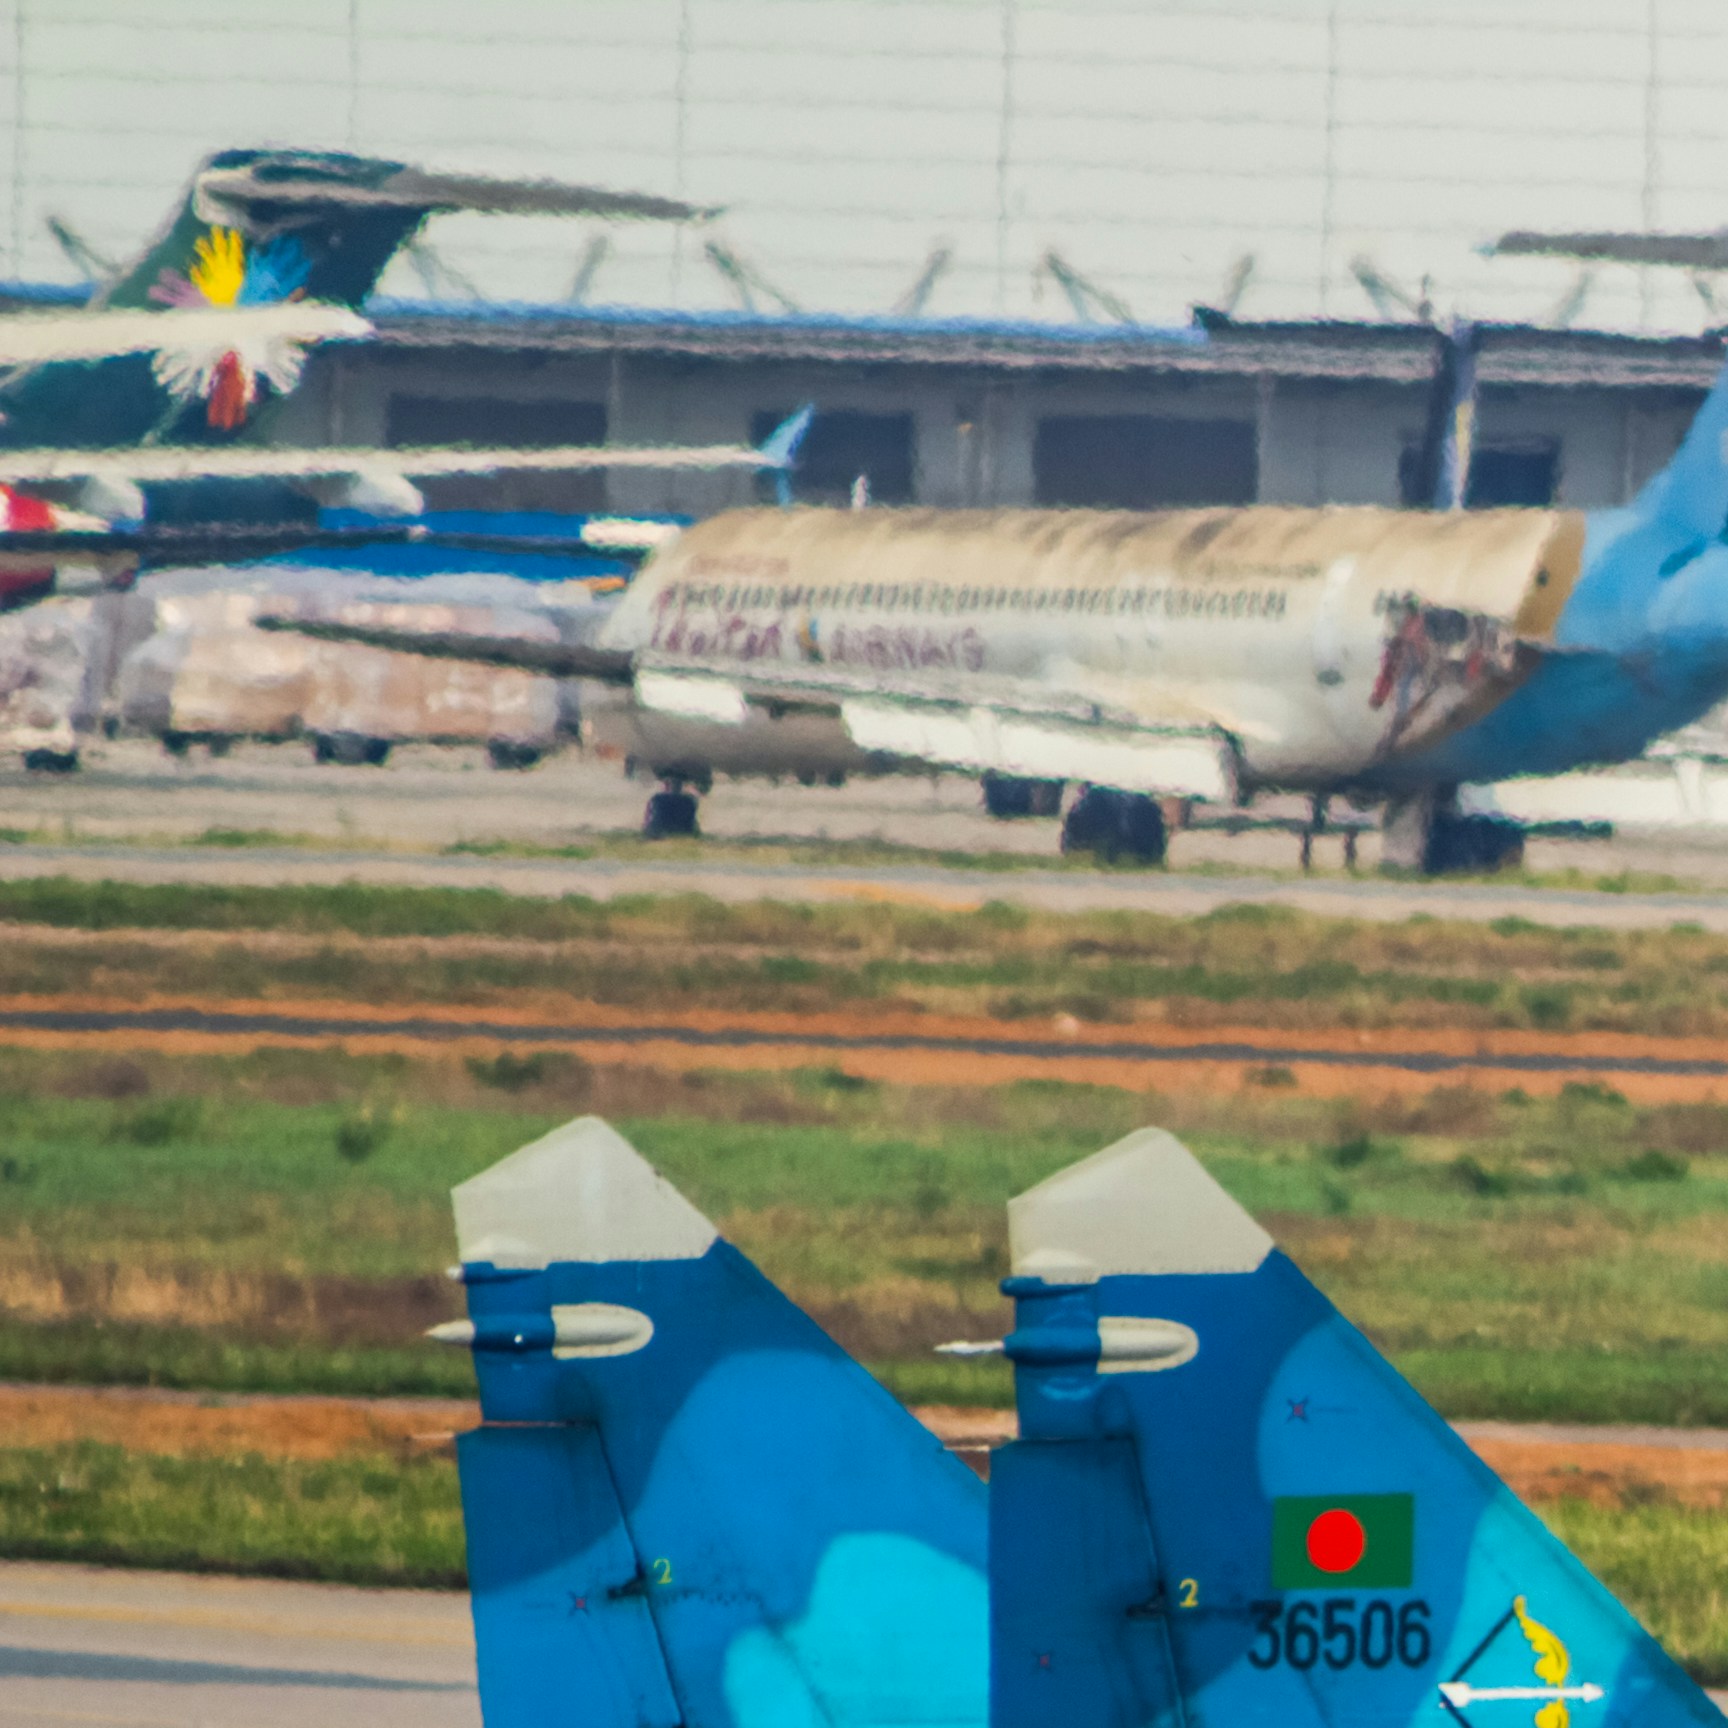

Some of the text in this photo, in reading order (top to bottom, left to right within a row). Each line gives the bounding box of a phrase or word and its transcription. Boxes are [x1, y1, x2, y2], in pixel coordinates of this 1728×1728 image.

[653, 1558, 672, 1585] 2
[1179, 1578, 1199, 1607] 2
[1248, 1599, 1430, 1671] 36506
